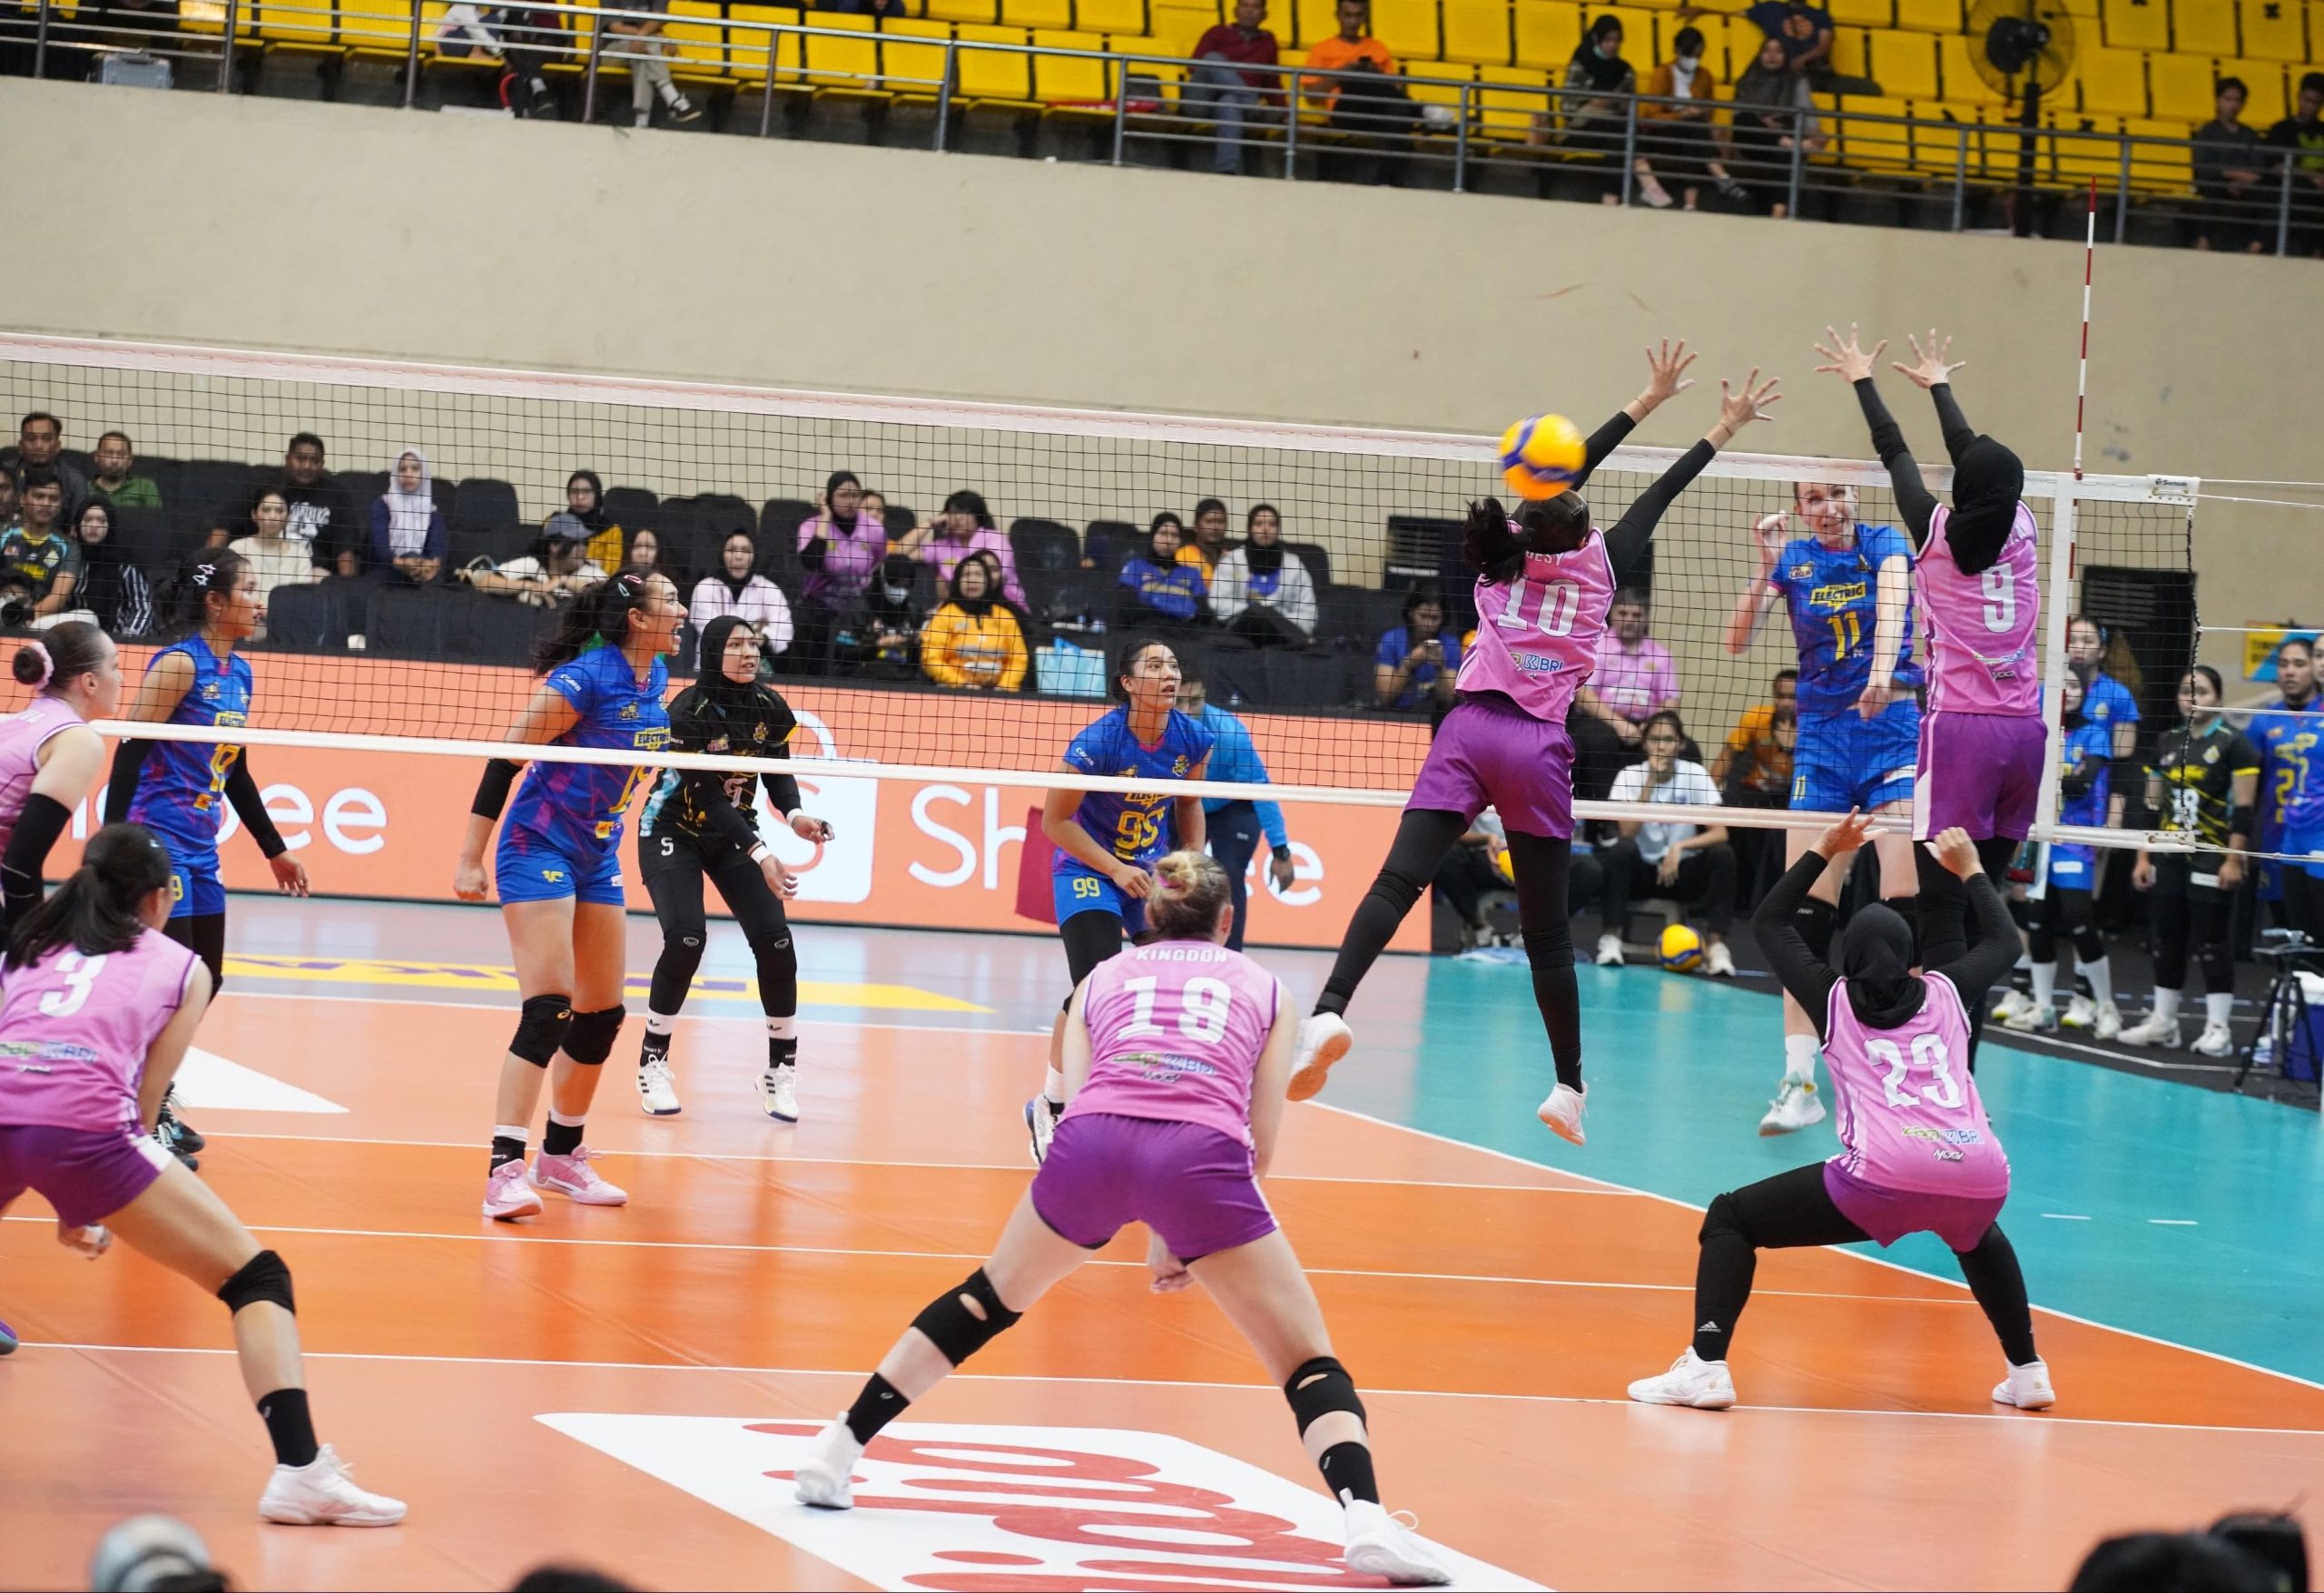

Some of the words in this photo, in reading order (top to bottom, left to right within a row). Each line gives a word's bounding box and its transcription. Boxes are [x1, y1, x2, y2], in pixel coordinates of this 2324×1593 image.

[1497, 575, 1581, 637] 10
[1815, 585, 1863, 600] ELECTRIC
[1981, 562, 2016, 634] 9
[1827, 611, 1861, 661] 11
[1076, 747, 1095, 766] Canon
[1072, 877, 1101, 899] 99
[1136, 949, 1228, 963] KINGDON
[39, 951, 108, 1018] 3
[1864, 1033, 1964, 1109] 23
